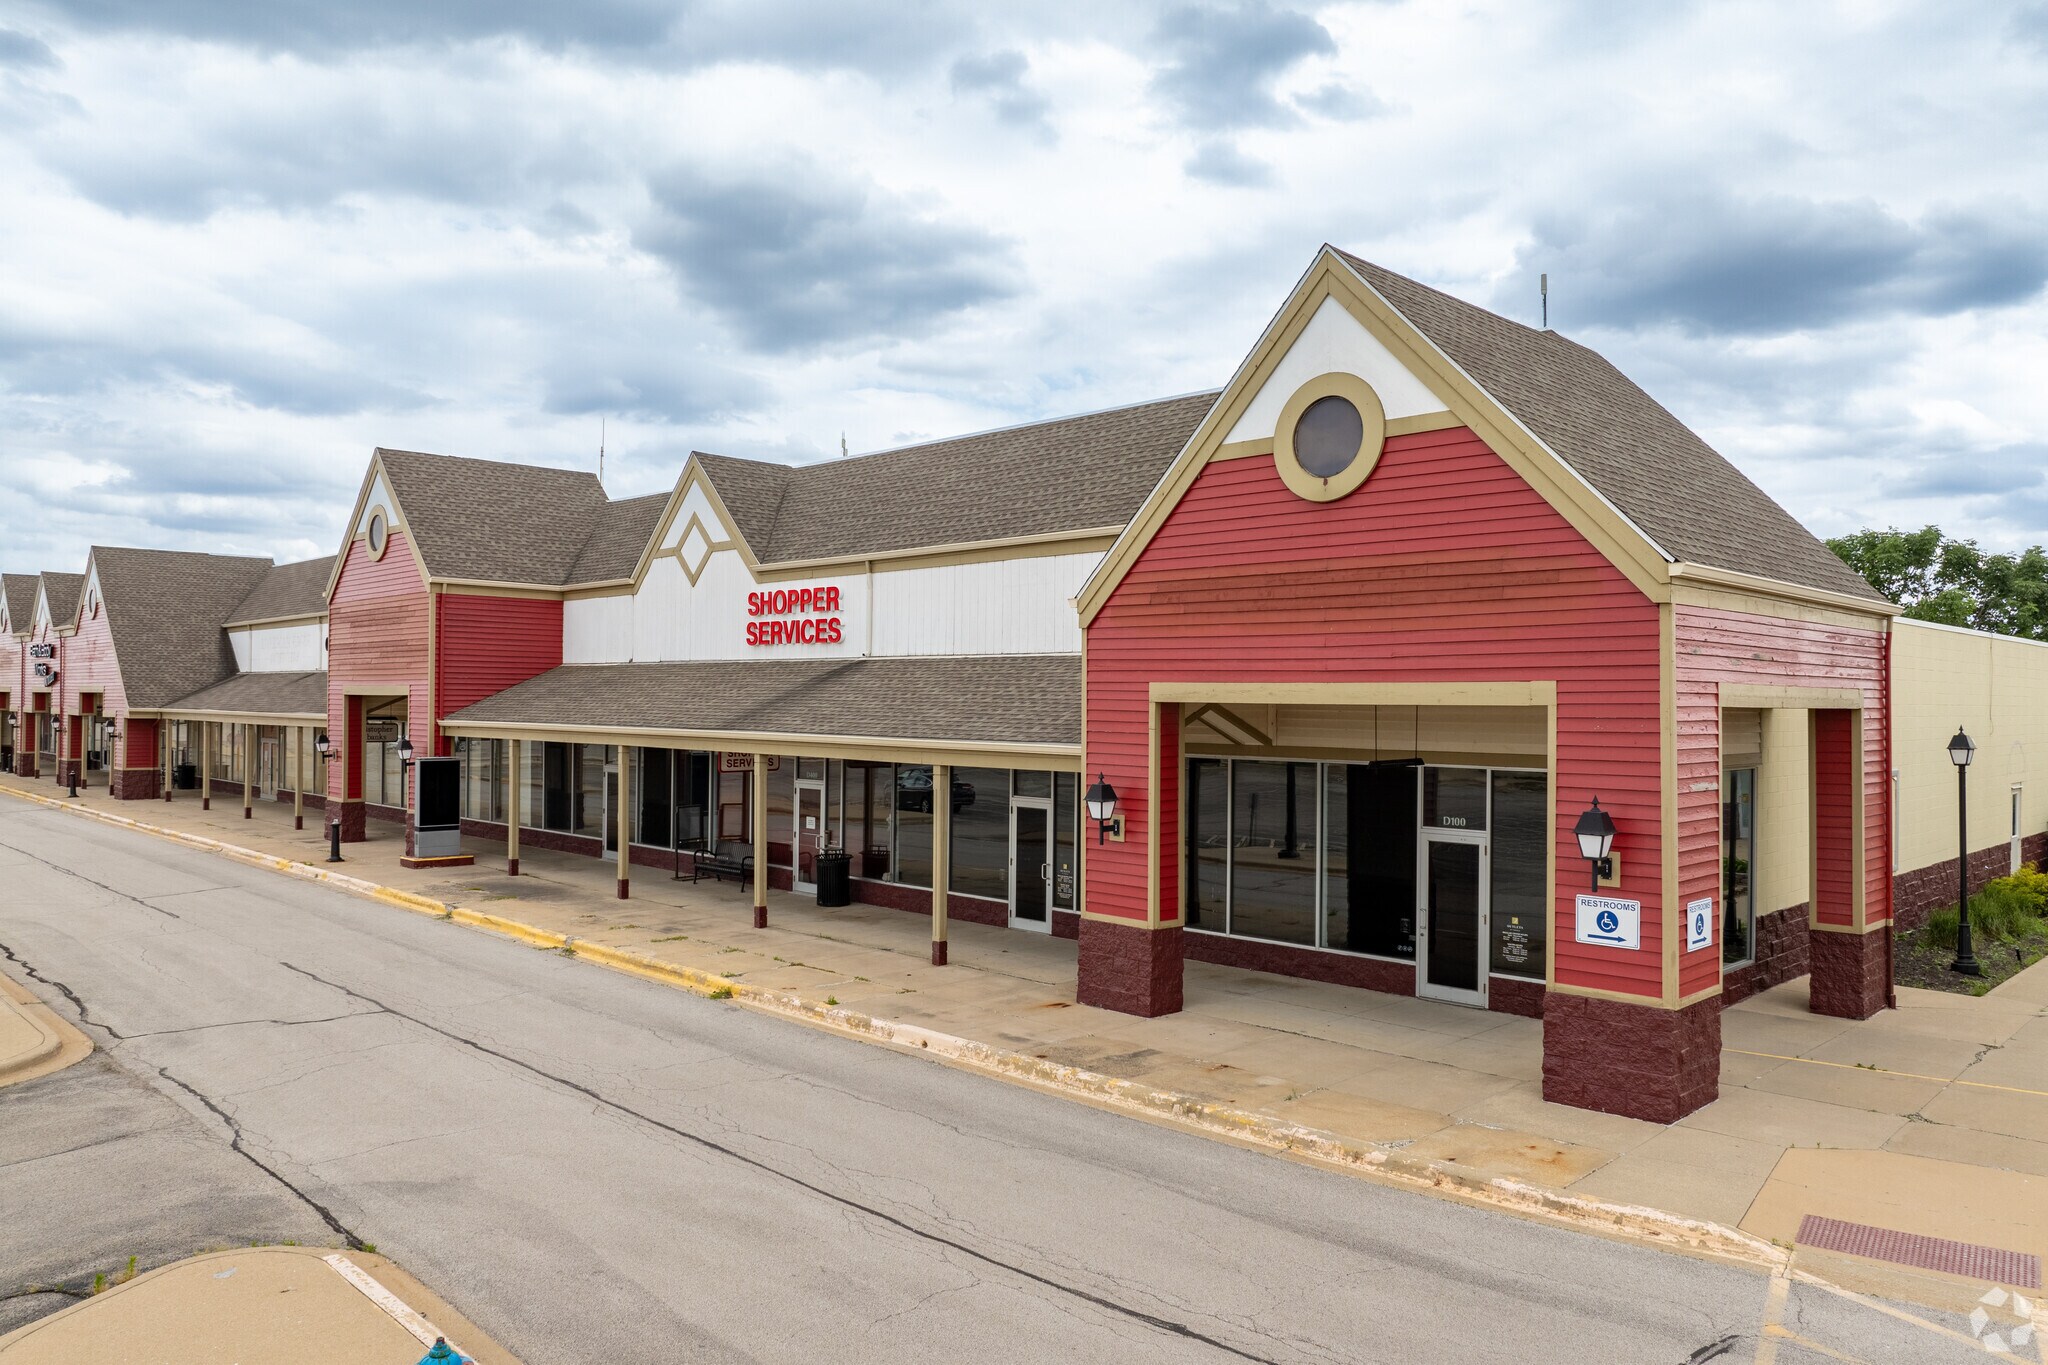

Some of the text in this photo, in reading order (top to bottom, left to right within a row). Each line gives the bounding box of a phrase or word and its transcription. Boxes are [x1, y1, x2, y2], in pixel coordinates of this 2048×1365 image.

[747, 586, 840, 616] SHOPPER
[746, 617, 842, 646] SERVICES
[1443, 816, 1466, 827] D100
[1581, 899, 1636, 912] RESTROOMS
[1689, 901, 1711, 913] RESTROOMS
